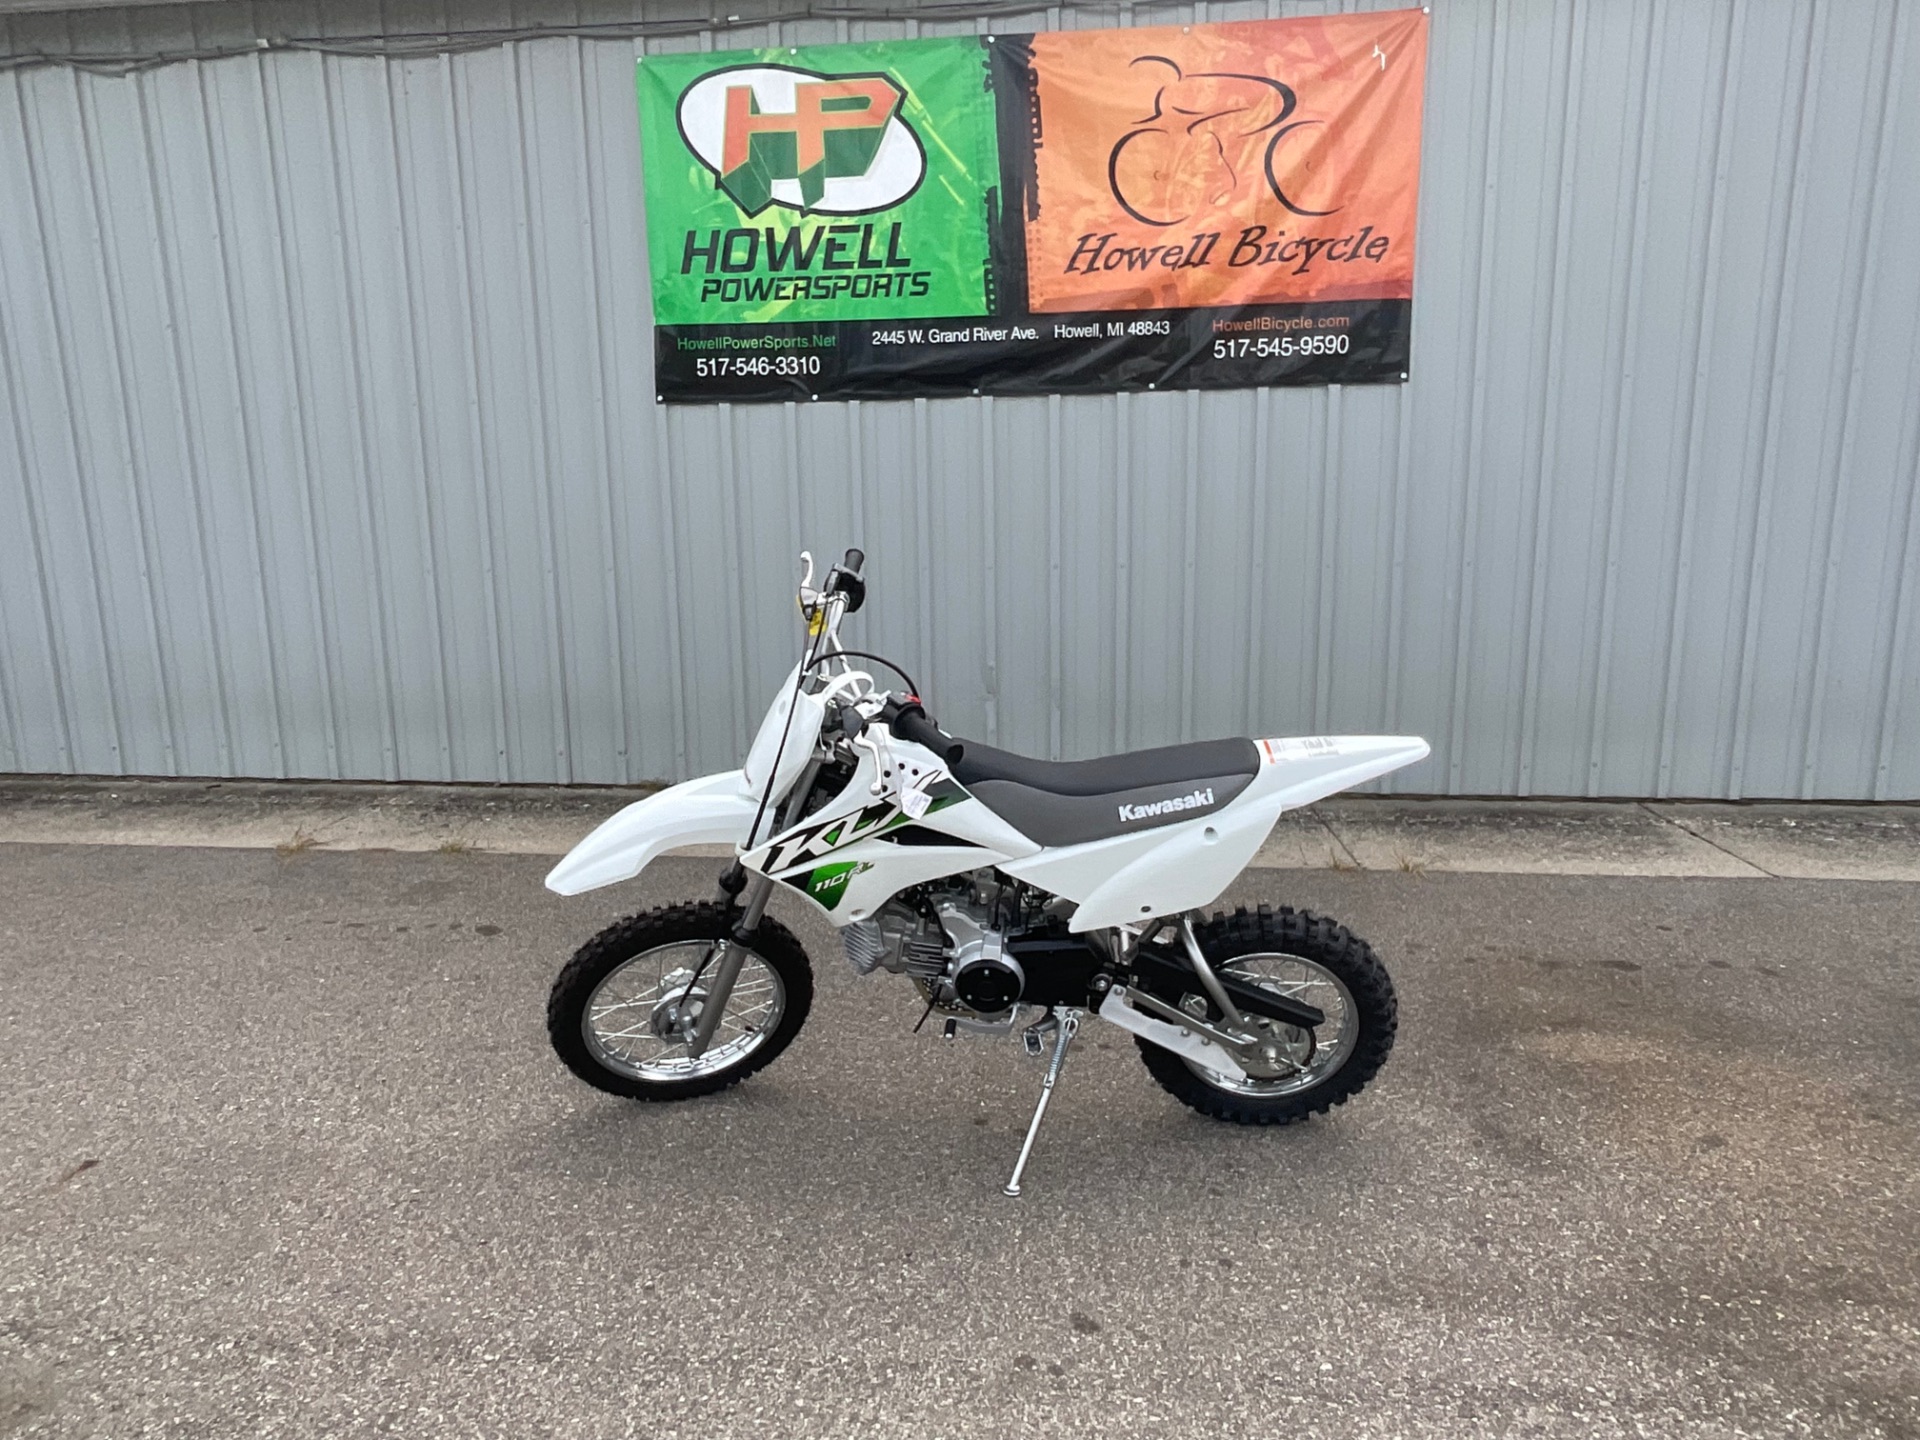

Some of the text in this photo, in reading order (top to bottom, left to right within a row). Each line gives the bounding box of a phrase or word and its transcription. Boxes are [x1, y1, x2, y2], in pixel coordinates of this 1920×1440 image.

[721, 77, 901, 190] HP
[680, 222, 911, 274] HOWELL
[1063, 225, 1390, 276] Howell Bicycle
[701, 271, 931, 302] POWERSPORTS
[872, 320, 1170, 346] 2445 W. Grand River Ave. Howell, MI 48843
[1212, 315, 1350, 334] HowellBicycle.com
[677, 334, 837, 351] HowellPowerSports.Net
[1213, 334, 1350, 360] 517-545-9590
[695, 355, 821, 377] 517-546-3310
[1117, 787, 1215, 823] Kawasaki
